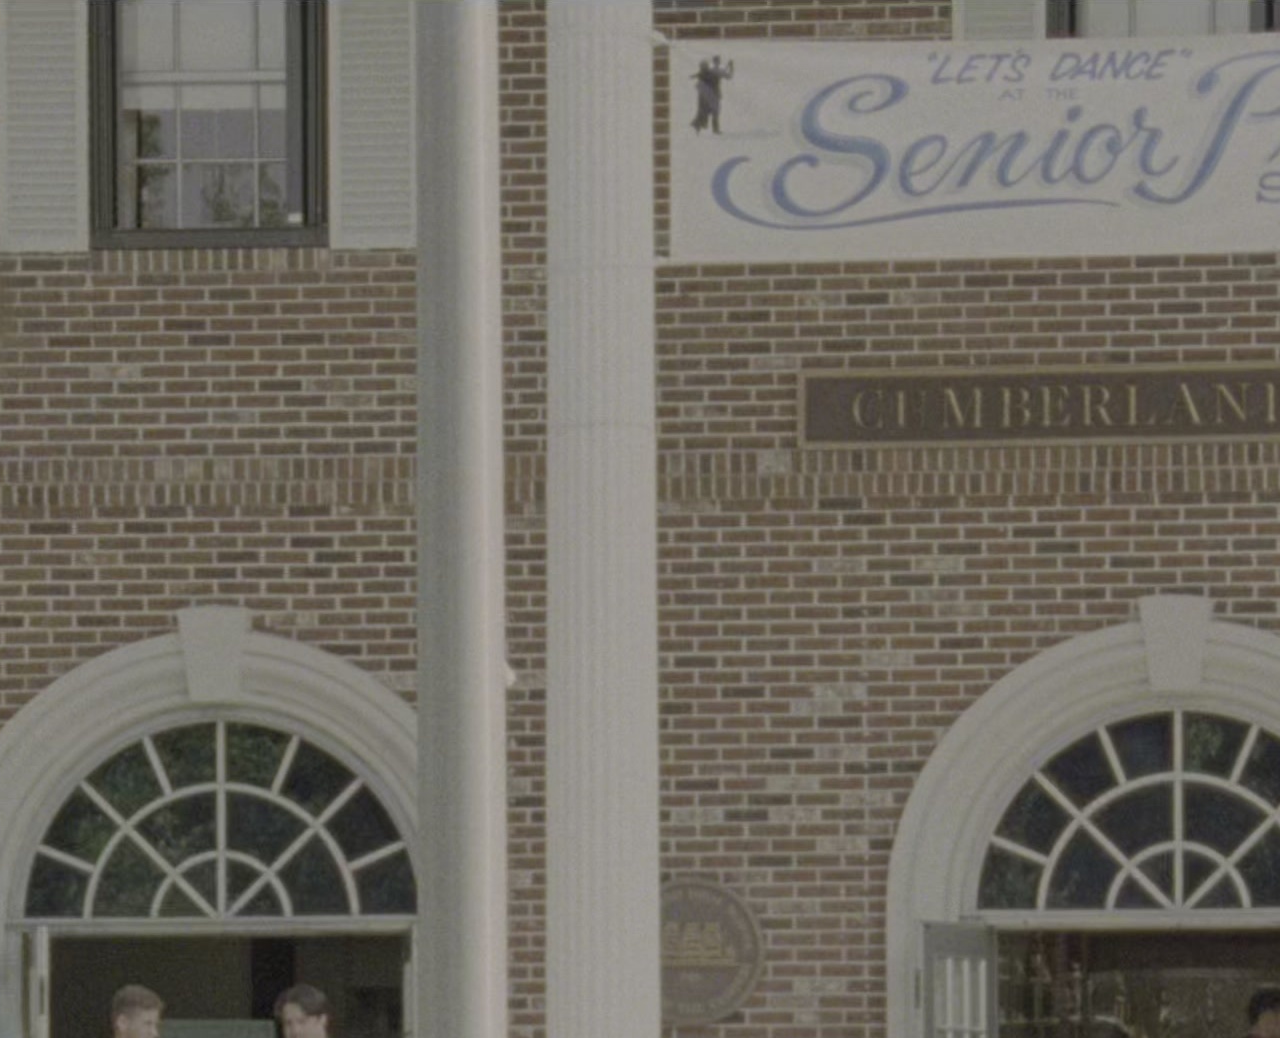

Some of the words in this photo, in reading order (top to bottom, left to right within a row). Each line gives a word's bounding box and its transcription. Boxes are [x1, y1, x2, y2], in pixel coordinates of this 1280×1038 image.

[1049, 48, 1192, 82] DANCE"
[998, 87, 1024, 100] AT
[1046, 87, 1078, 100] THE
[766, 73, 1179, 217] Senior
